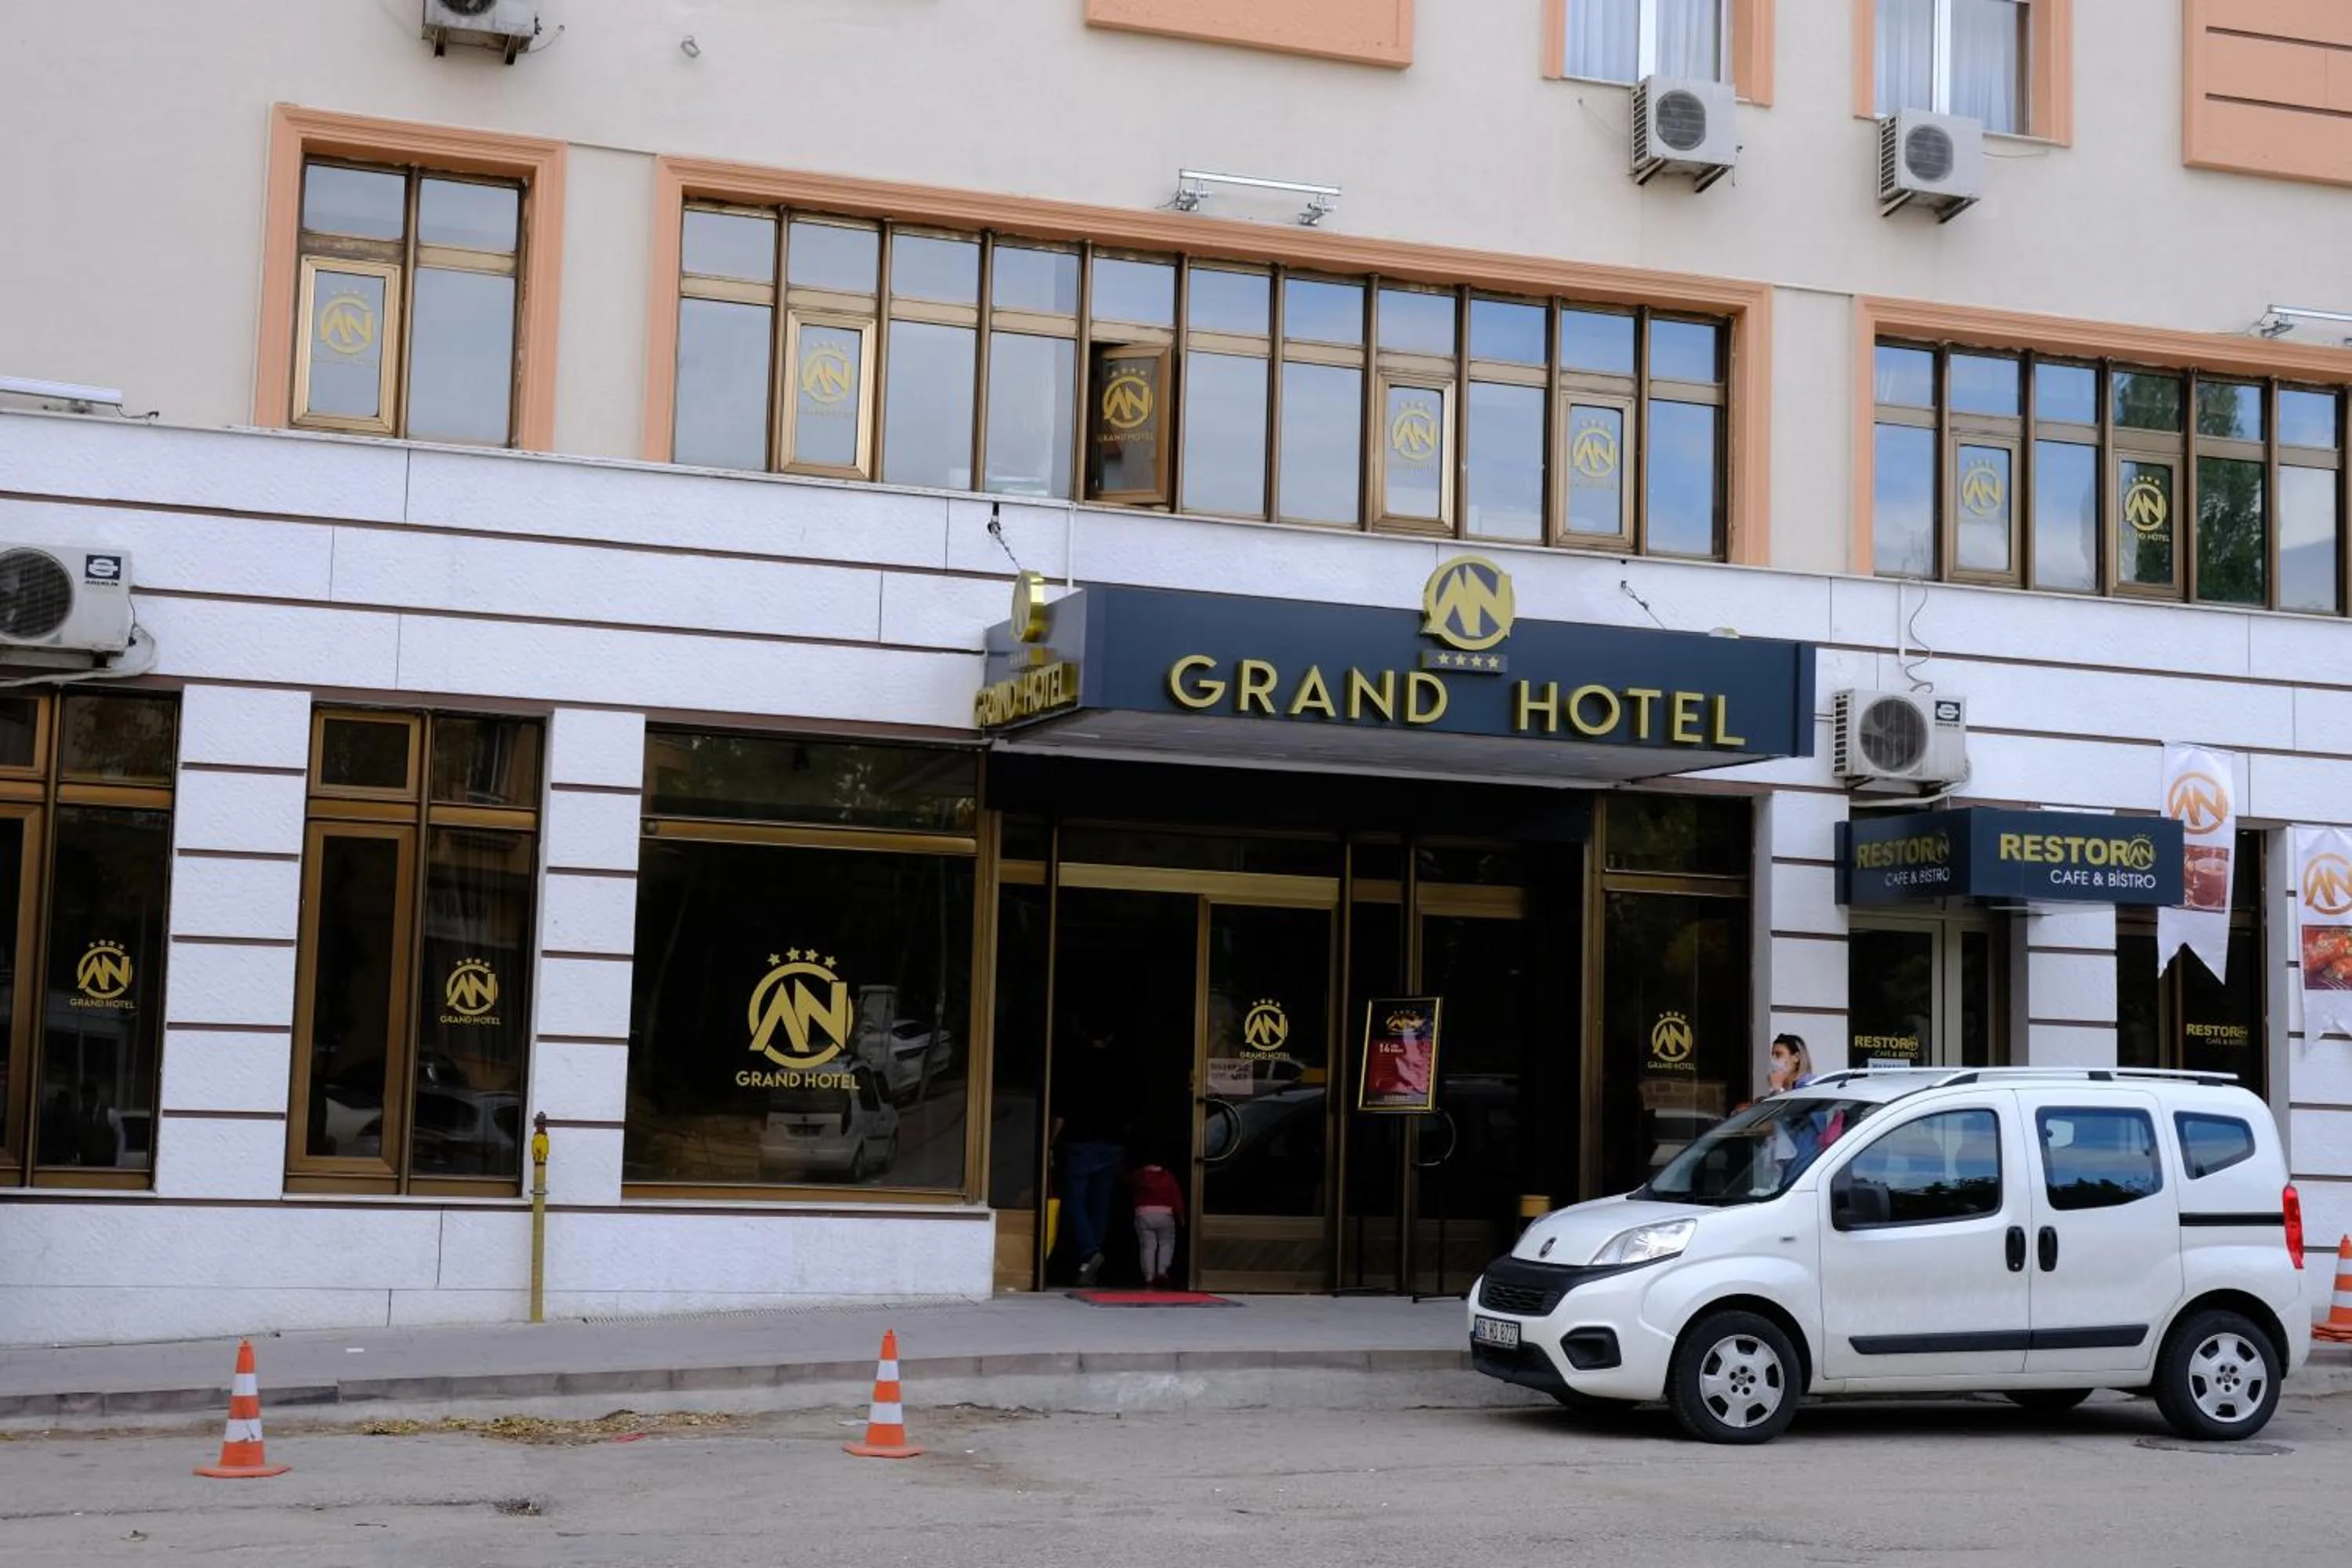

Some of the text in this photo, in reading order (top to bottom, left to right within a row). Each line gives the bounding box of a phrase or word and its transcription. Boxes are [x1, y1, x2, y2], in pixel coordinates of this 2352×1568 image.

[975, 660, 1067, 728] GRAND HOTEL
[1167, 654, 1746, 746] GRAND HOTEL
[1885, 870, 1908, 887] CAFE
[2049, 869, 2156, 889] CAFE & BİSTRO
[70, 998, 135, 1009] GRAND HOTEL
[440, 1015, 501, 1025] GRAND HOTEL
[735, 1070, 860, 1090] GRAND HOTEL
